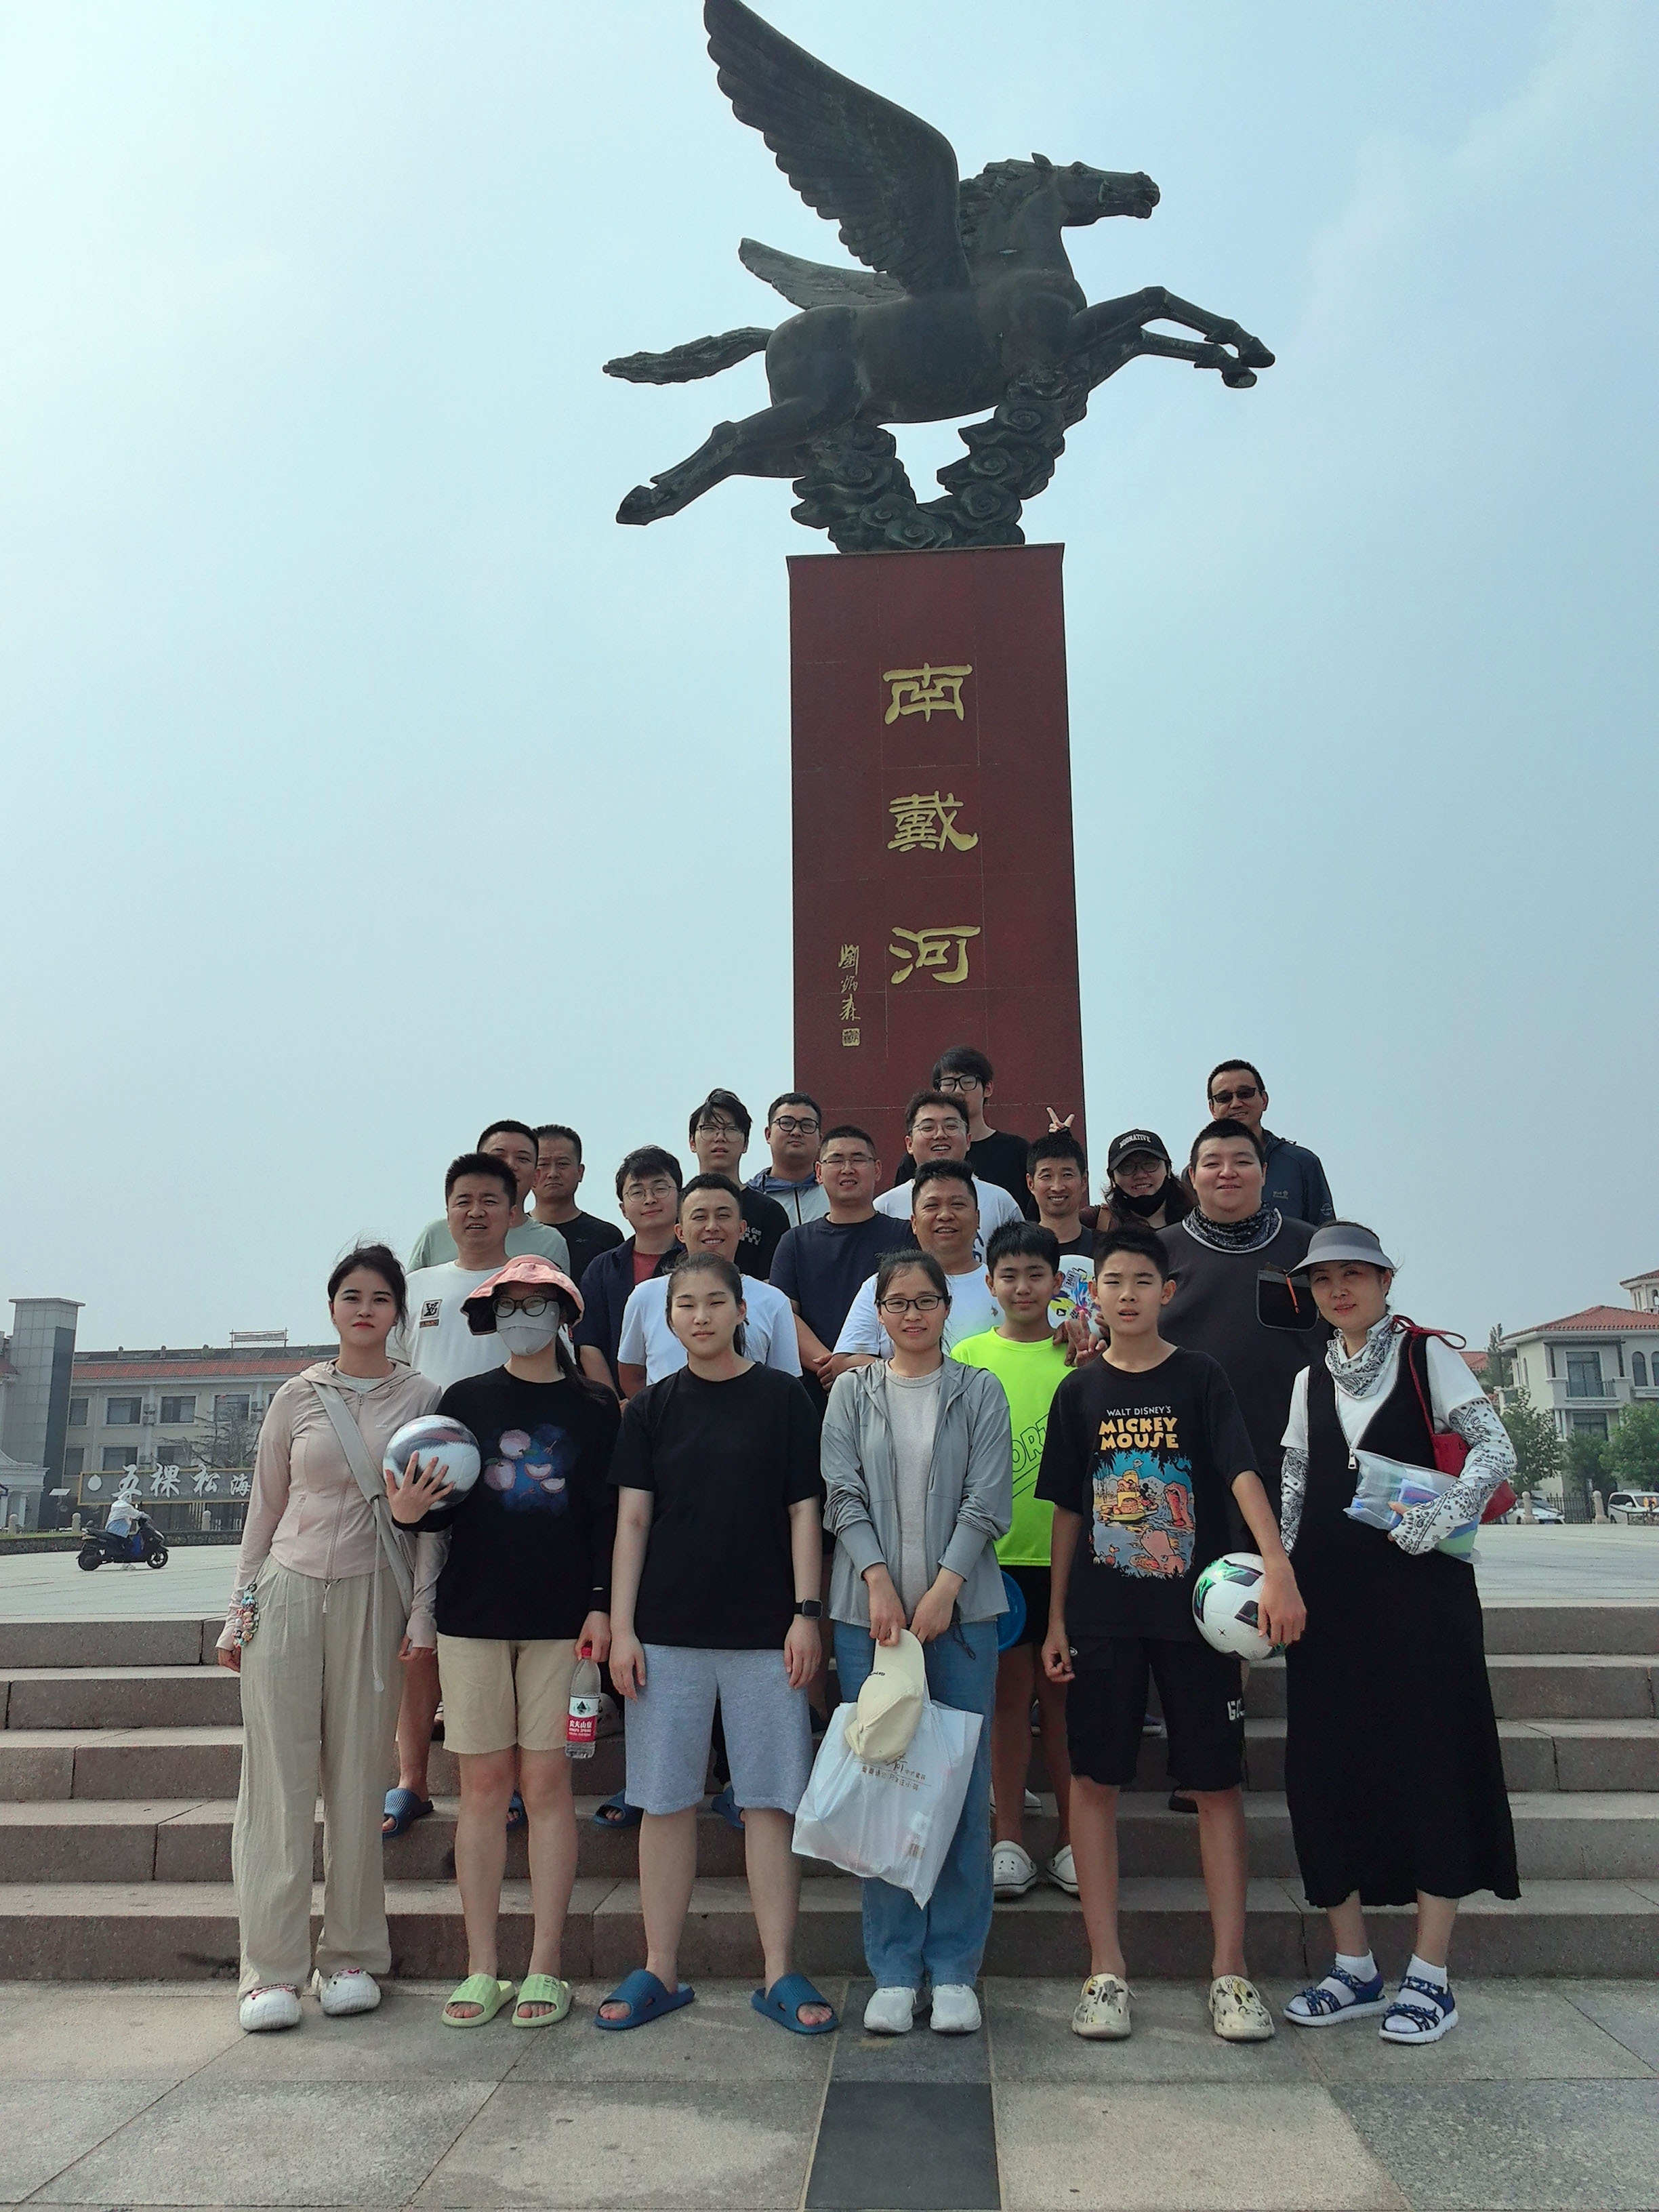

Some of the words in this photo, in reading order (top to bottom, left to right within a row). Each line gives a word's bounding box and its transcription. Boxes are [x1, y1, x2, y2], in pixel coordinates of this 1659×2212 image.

[883, 662, 981, 985] 南戴河
[1106, 1408, 1132, 1417] WALT
[1134, 1405, 1172, 1416] DISNEY'S
[1099, 1416, 1179, 1435] MICKEY
[1100, 1431, 1179, 1451] MOUSE
